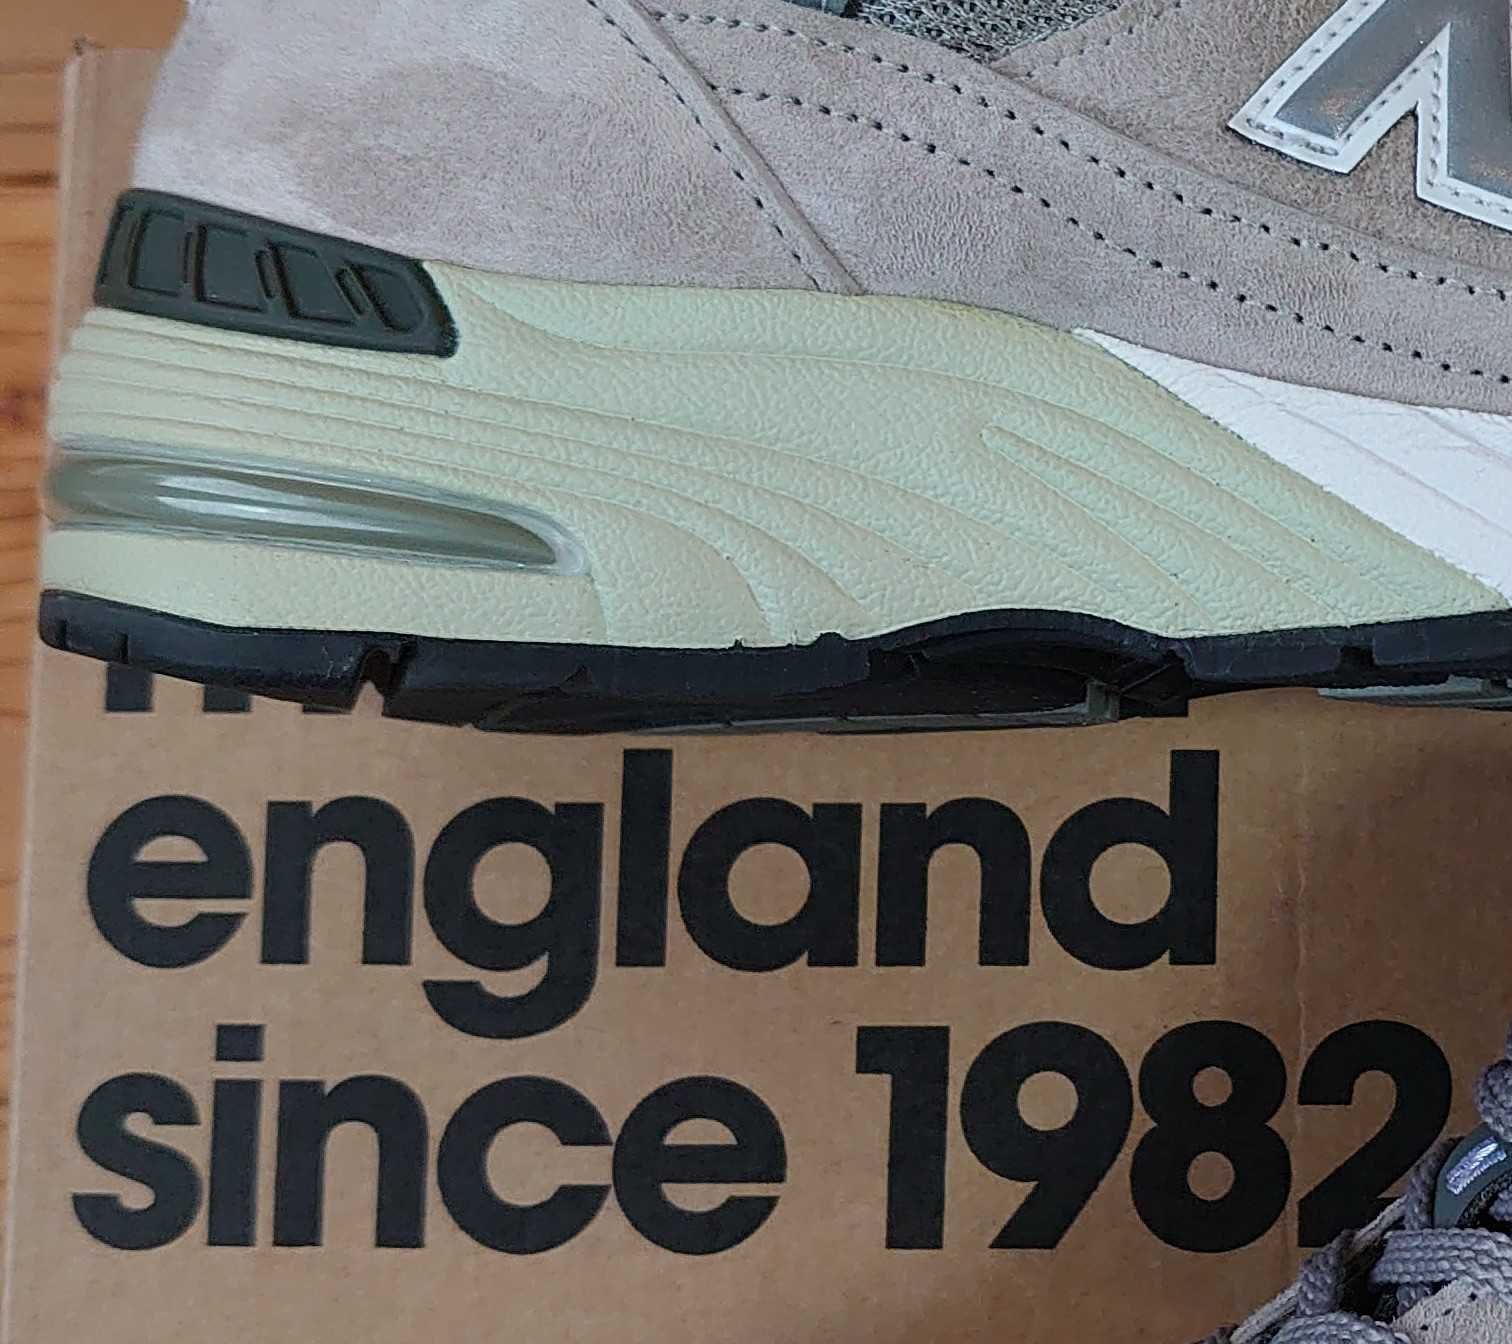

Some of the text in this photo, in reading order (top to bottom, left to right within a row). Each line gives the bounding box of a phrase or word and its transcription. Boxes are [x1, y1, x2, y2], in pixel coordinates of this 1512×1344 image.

[86, 747, 1221, 1041] england
[71, 1020, 1453, 1257] since 1982
